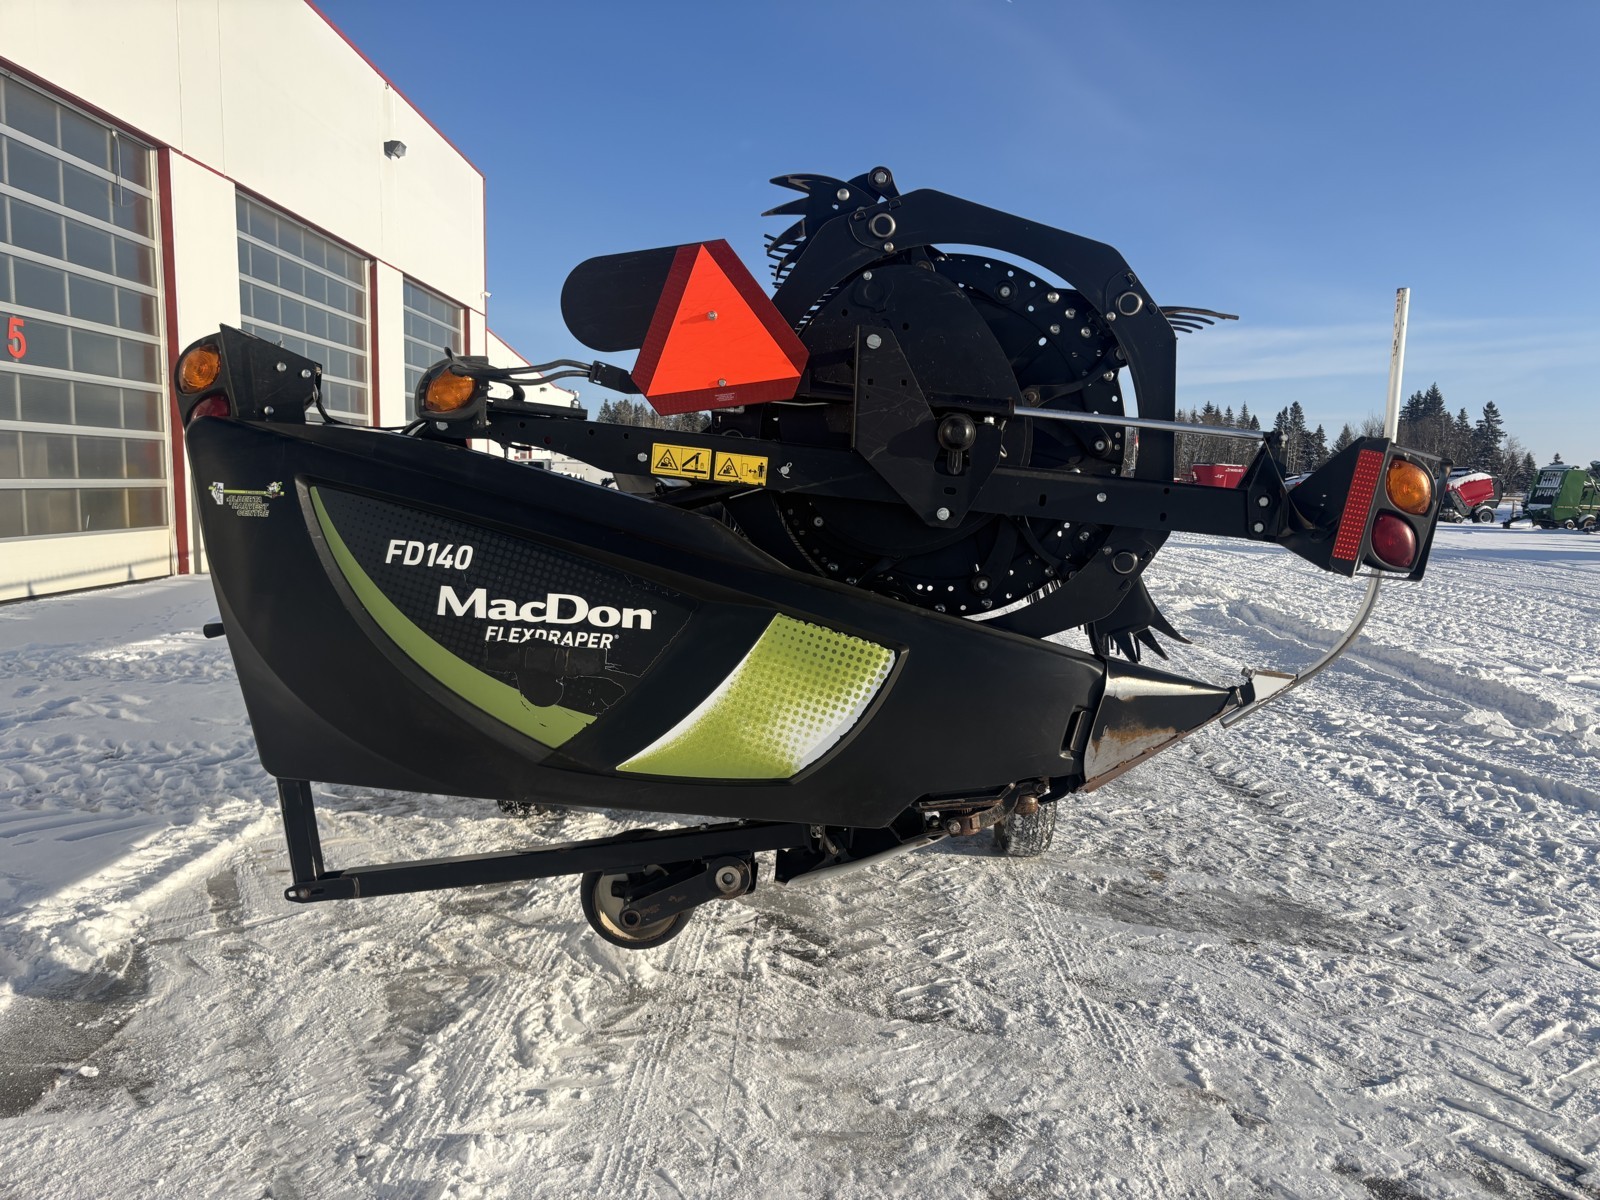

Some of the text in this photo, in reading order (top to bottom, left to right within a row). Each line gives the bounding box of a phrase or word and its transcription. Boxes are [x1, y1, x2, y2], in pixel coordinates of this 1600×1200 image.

[8, 317, 27, 359] 5
[226, 495, 262, 505] ALBERTA
[385, 539, 474, 571] FD140
[436, 585, 653, 630] MacDon
